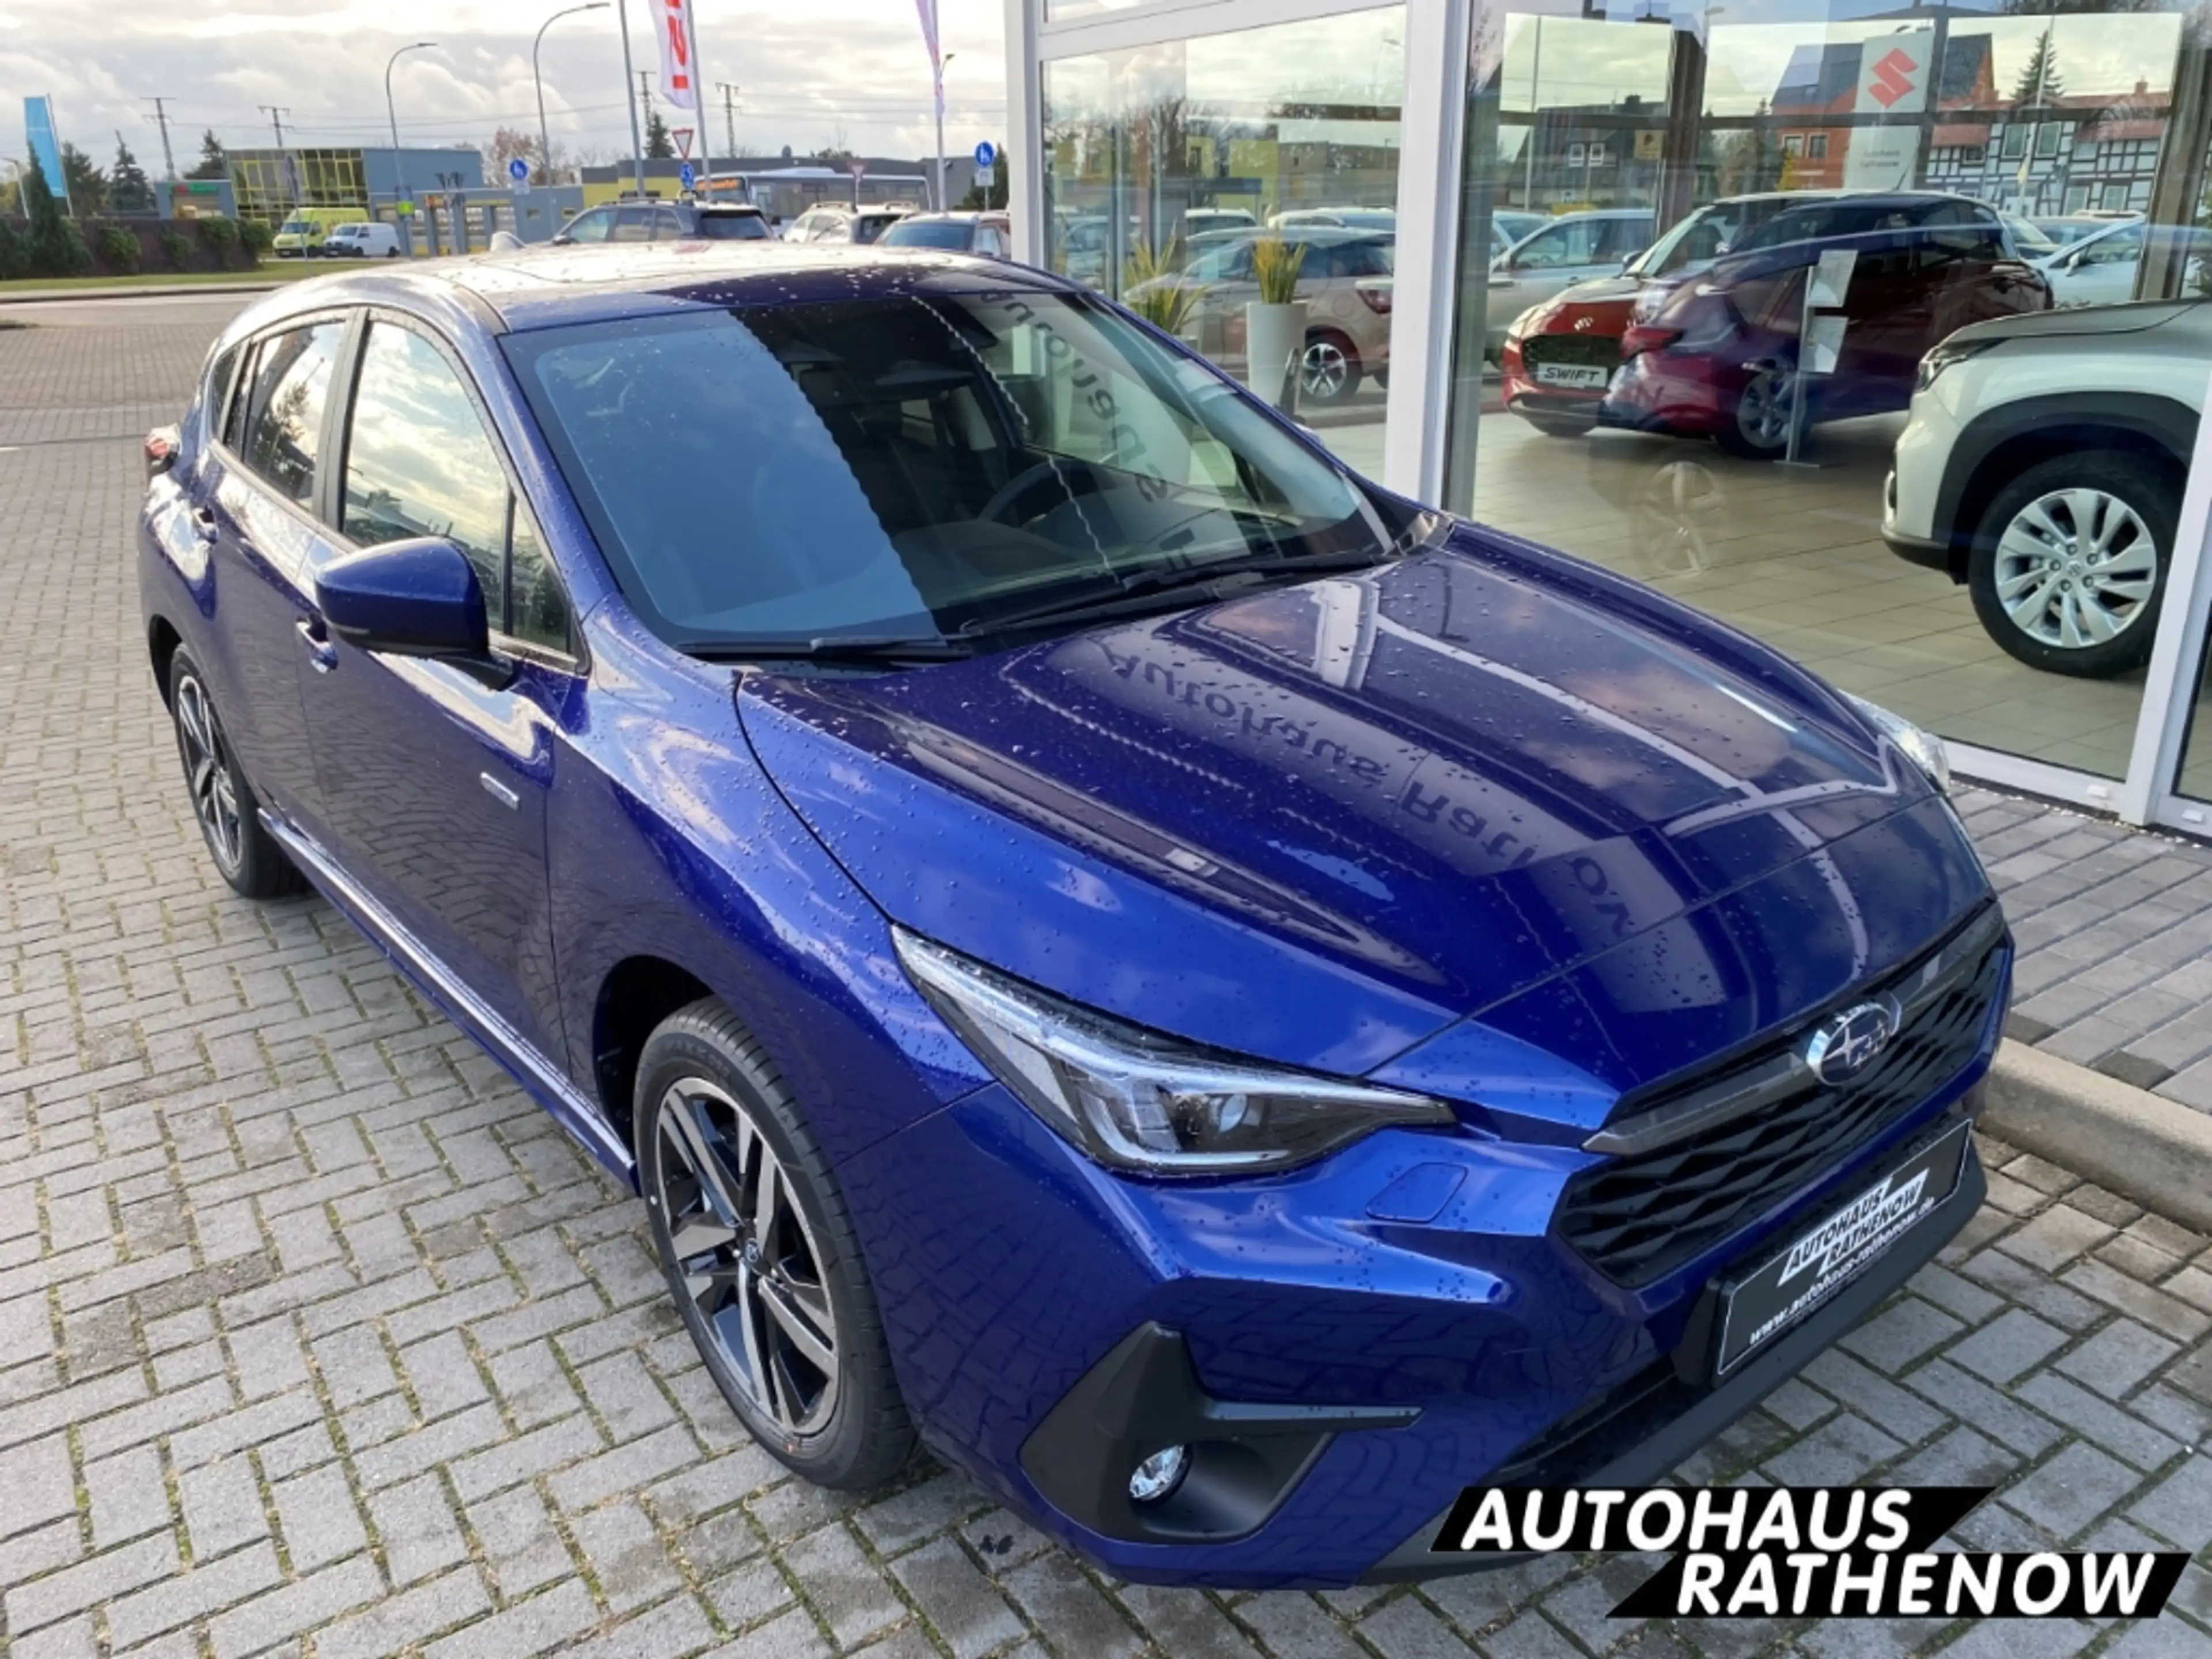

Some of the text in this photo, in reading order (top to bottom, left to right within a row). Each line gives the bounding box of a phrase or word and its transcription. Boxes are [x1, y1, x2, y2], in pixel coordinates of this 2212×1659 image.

[1544, 367, 1600, 382] SWIFT
[1786, 1186, 1885, 1275] AUTOHAUS
[1827, 1178, 1923, 1267] RATHENOW
